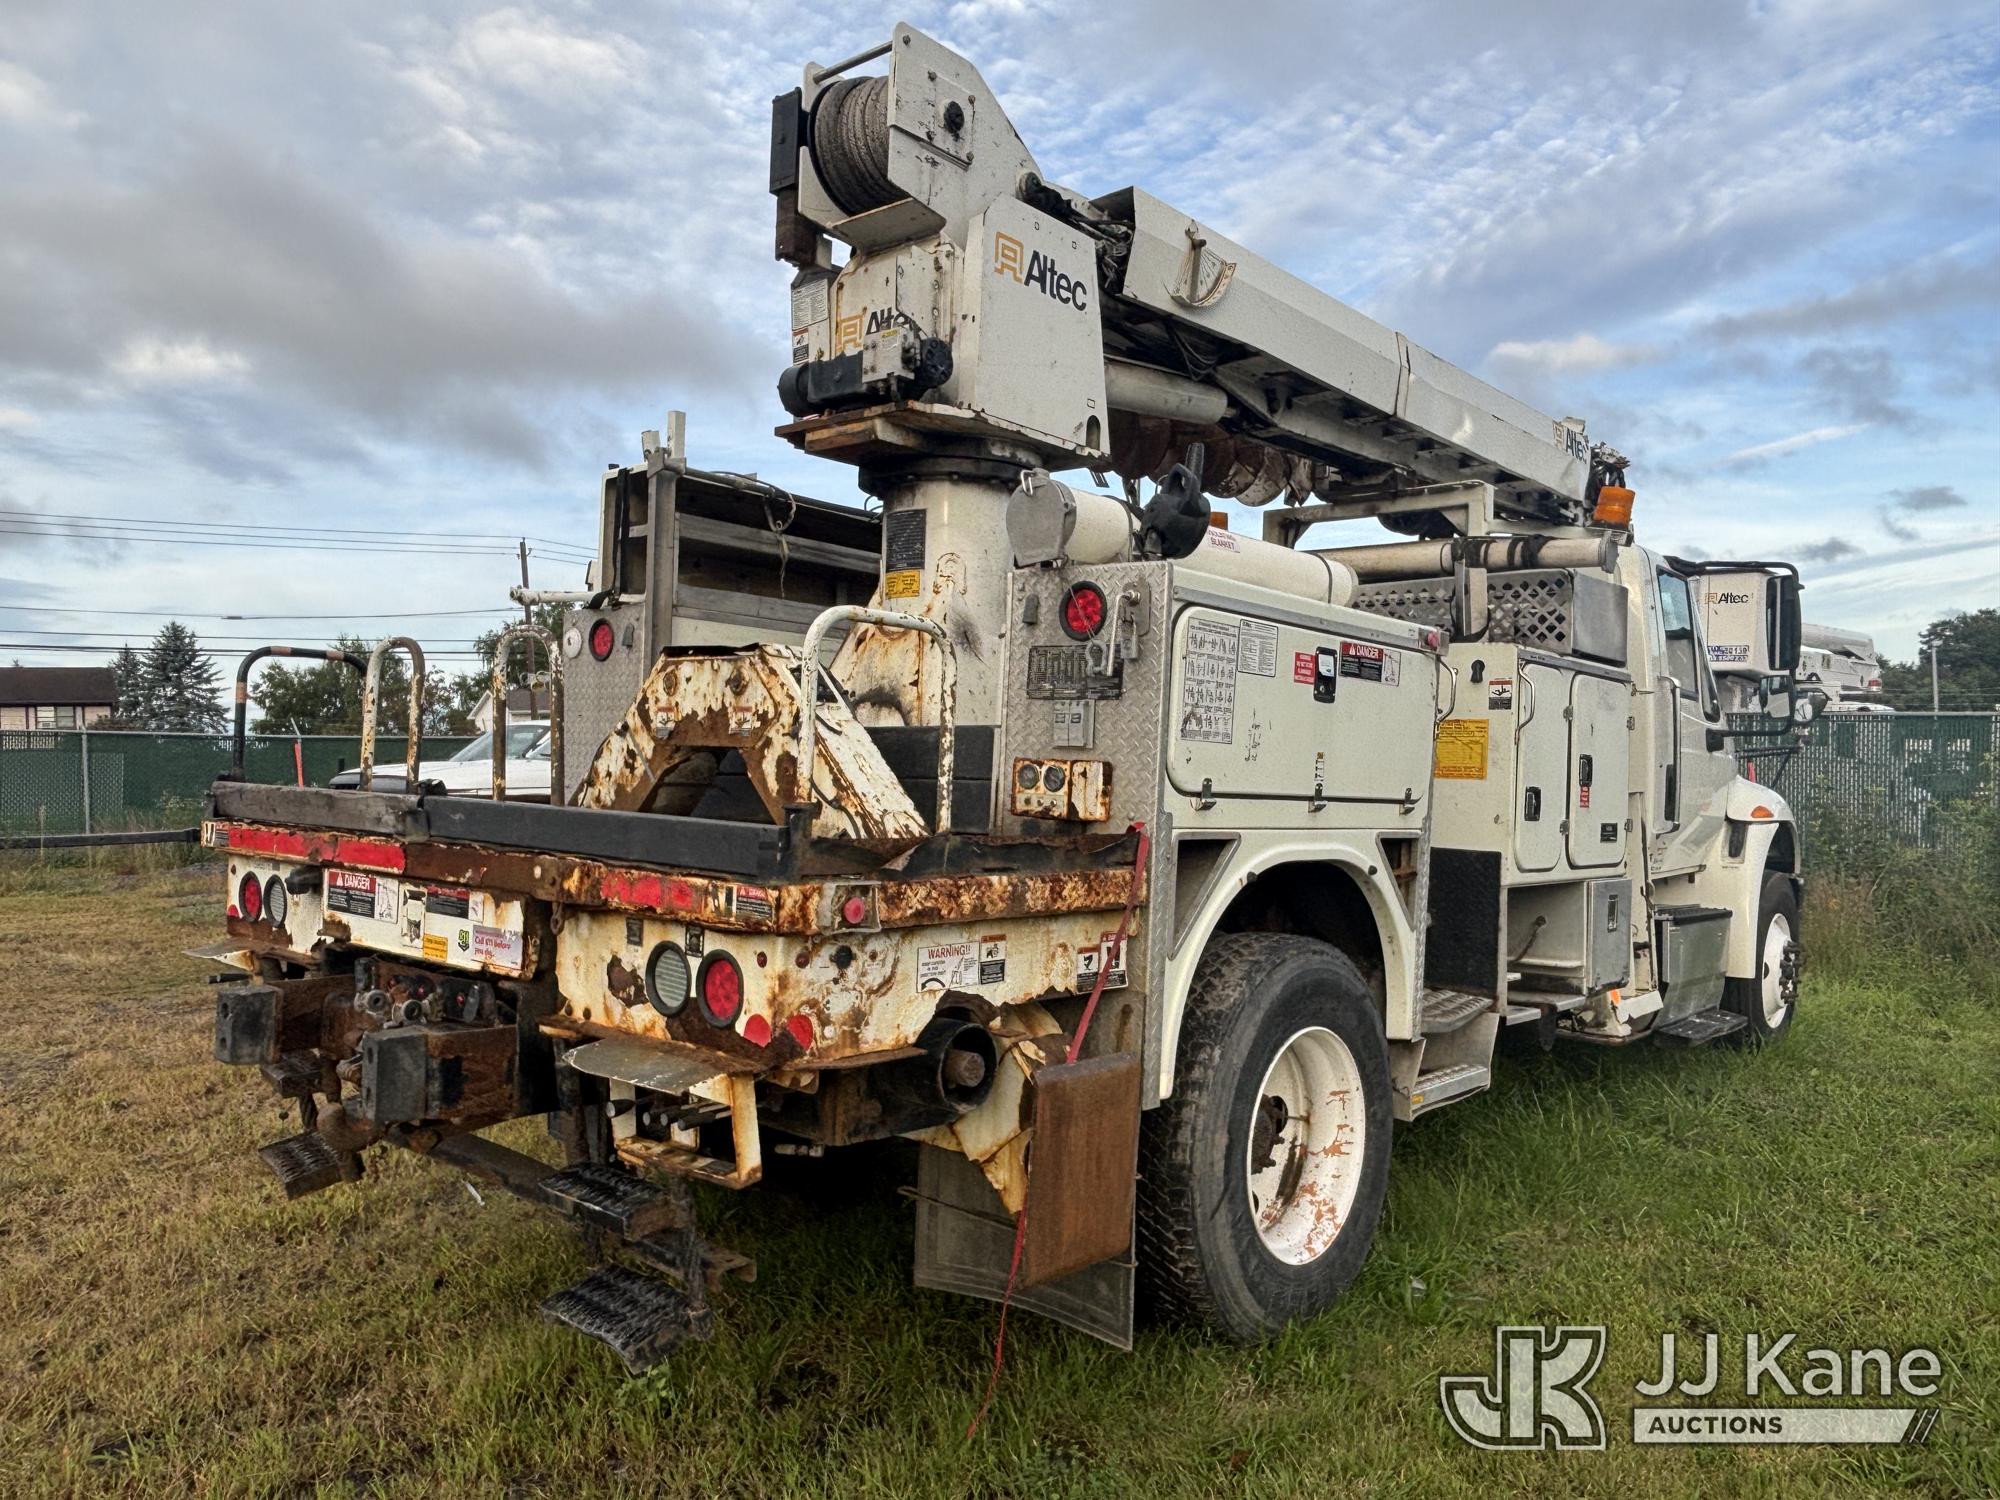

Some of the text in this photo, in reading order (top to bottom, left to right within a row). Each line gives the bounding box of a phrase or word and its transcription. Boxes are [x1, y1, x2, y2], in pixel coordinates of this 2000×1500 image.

[1024, 250, 1087, 312] Altec
[1718, 592, 1749, 604] Altec
[1356, 644, 1379, 659] DANGER
[344, 874, 370, 890] DANGER
